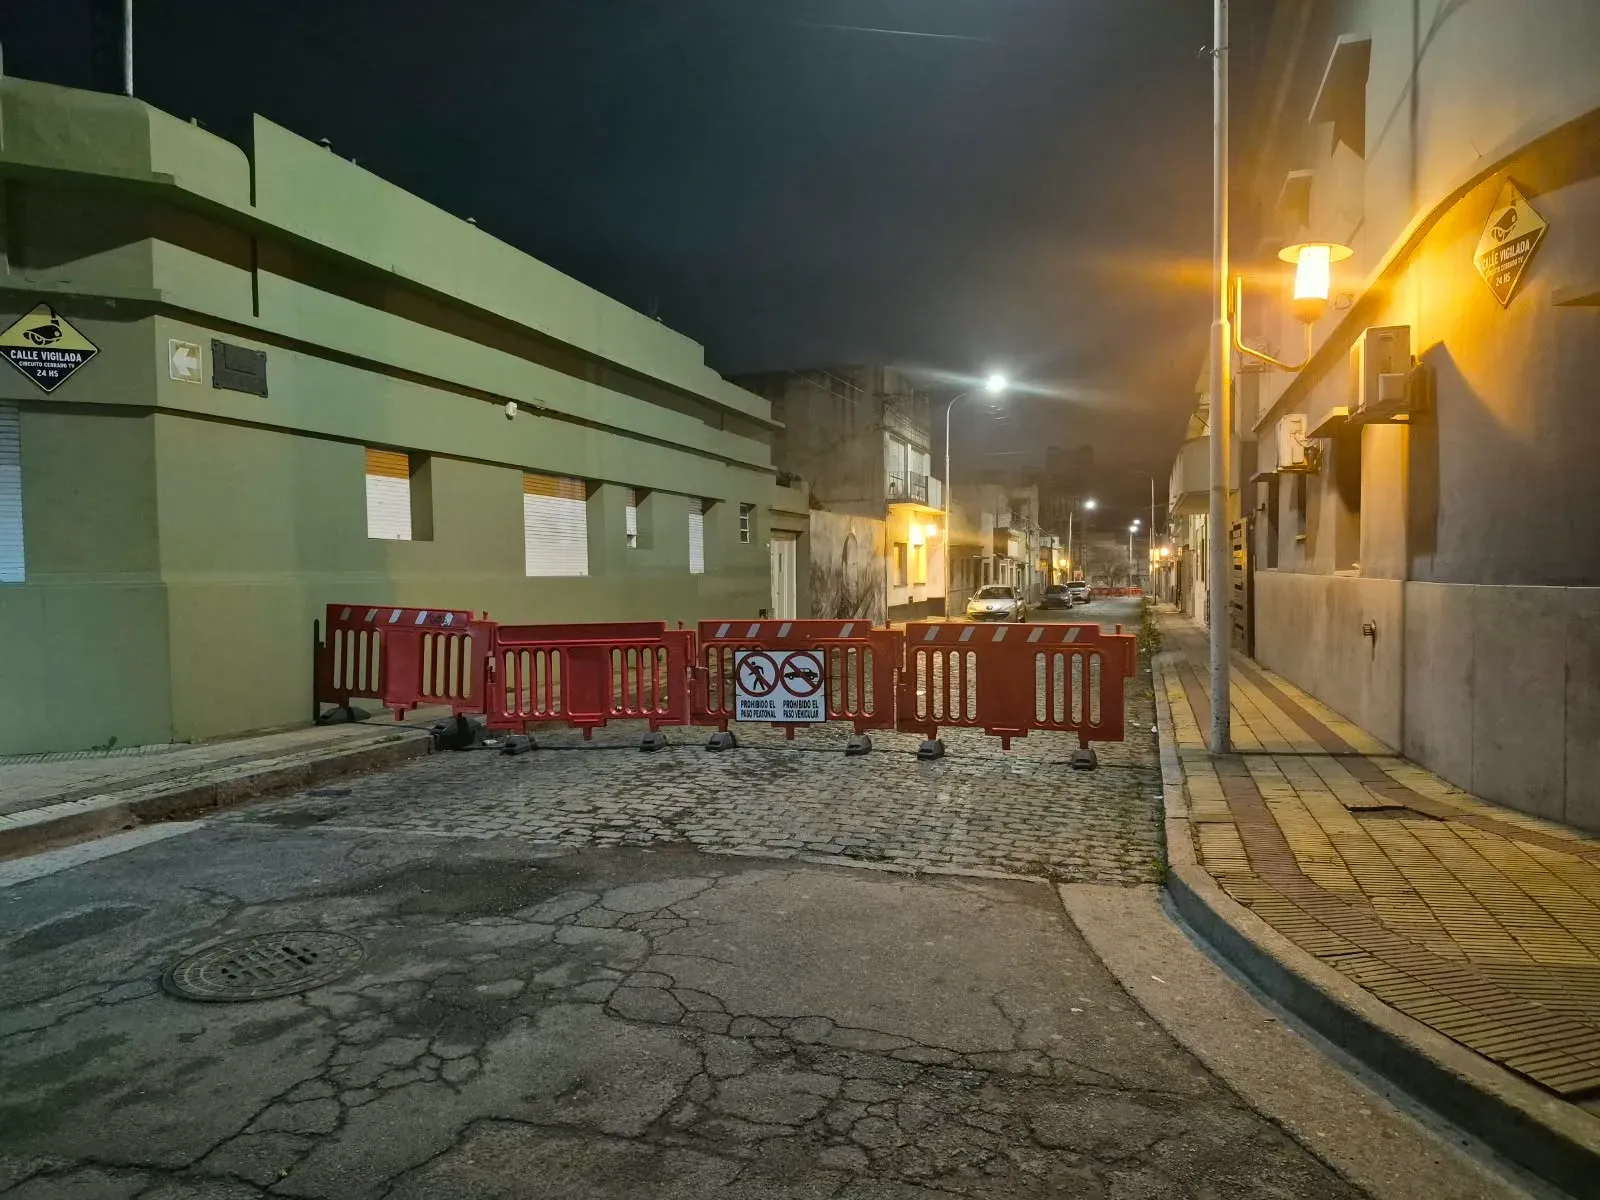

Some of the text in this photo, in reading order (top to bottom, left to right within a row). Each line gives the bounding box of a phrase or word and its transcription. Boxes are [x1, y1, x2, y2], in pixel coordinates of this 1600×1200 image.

[1500, 239, 1530, 262] VIGILADA
[1495, 276, 1502, 287] 24
[1504, 272, 1511, 283] HS
[10, 350, 82, 362] CALLE VIGILADA
[740, 700, 776, 709] PROHIBIDO EL
[783, 700, 819, 709] PROHIBIDO EL
[740, 709, 776, 718] PASO PEATONAL
[783, 709, 819, 718] PASO VEHICULAR
